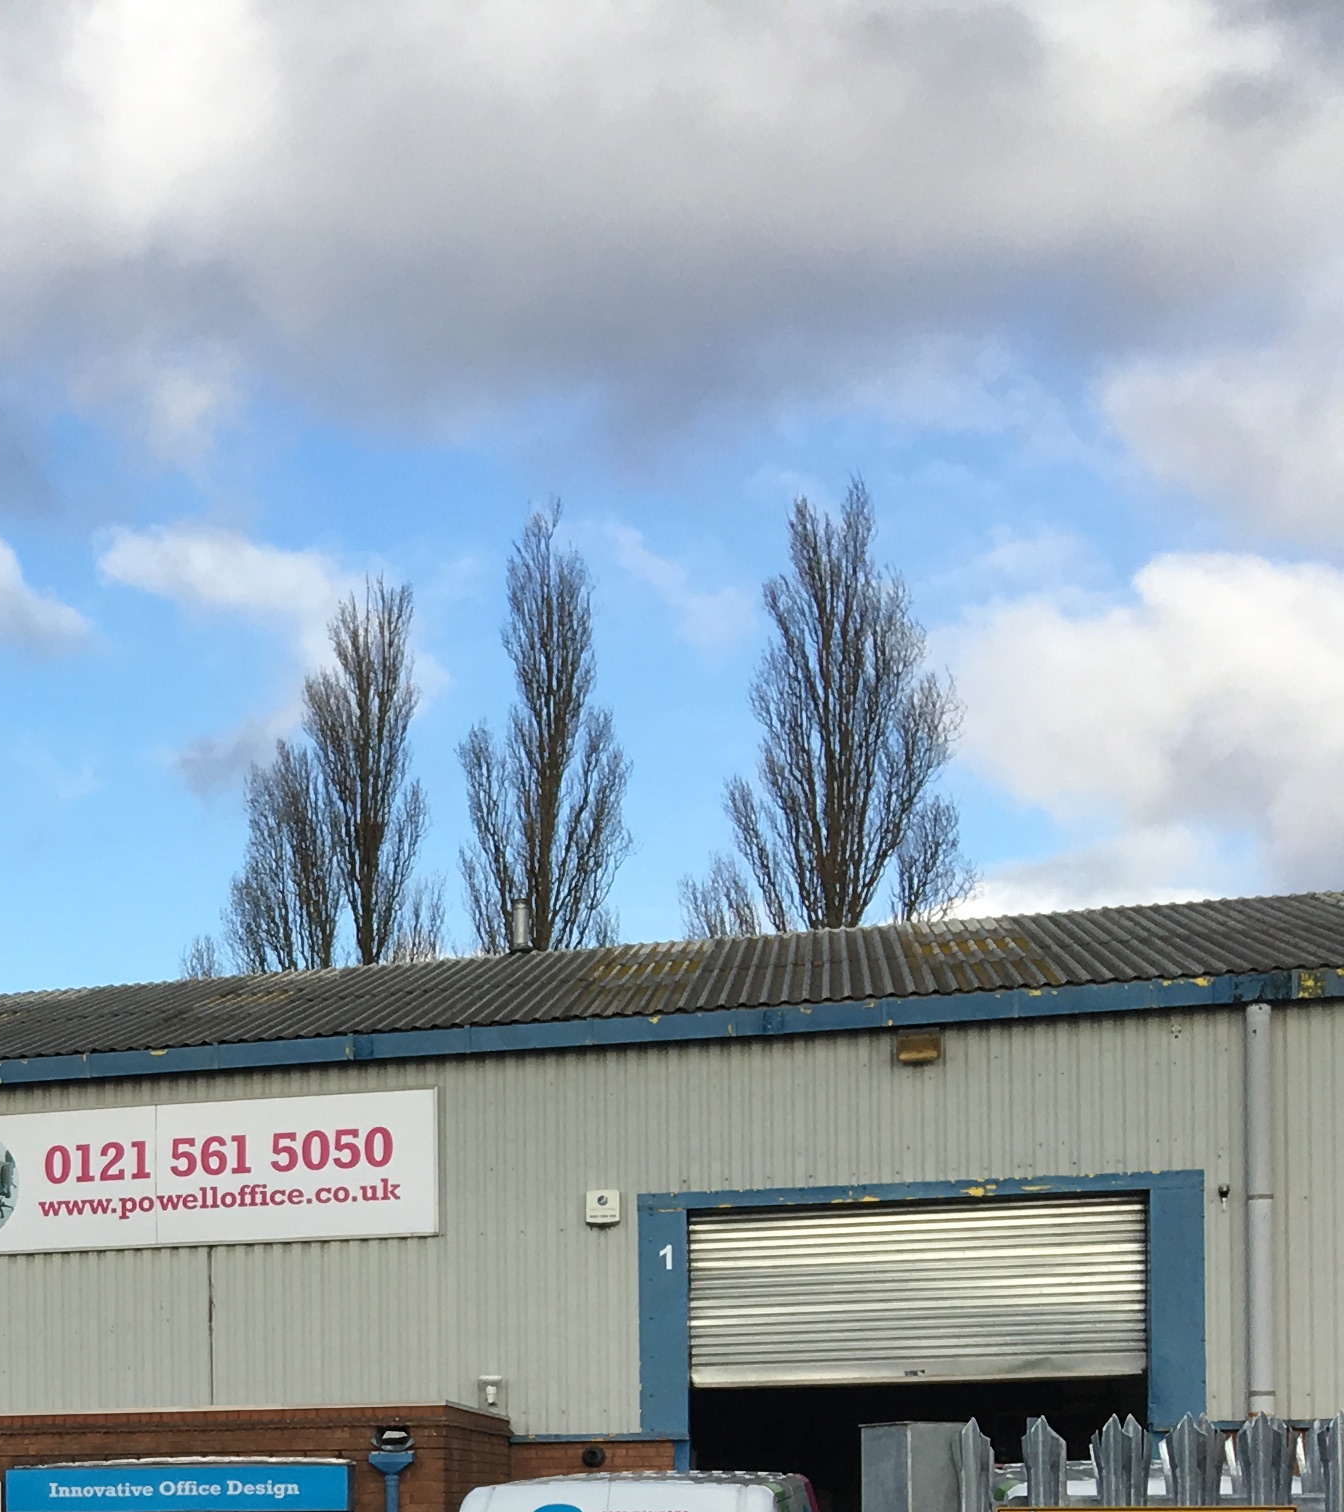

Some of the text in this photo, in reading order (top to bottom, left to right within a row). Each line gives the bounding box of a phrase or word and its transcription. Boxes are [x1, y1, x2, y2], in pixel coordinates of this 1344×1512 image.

[44, 1126, 394, 1185] 0121 561 5050
[38, 1178, 401, 1220] www.powelloffice.co.uk
[659, 1244, 672, 1270] 1
[49, 1480, 300, 1499] Innovative Office Design
